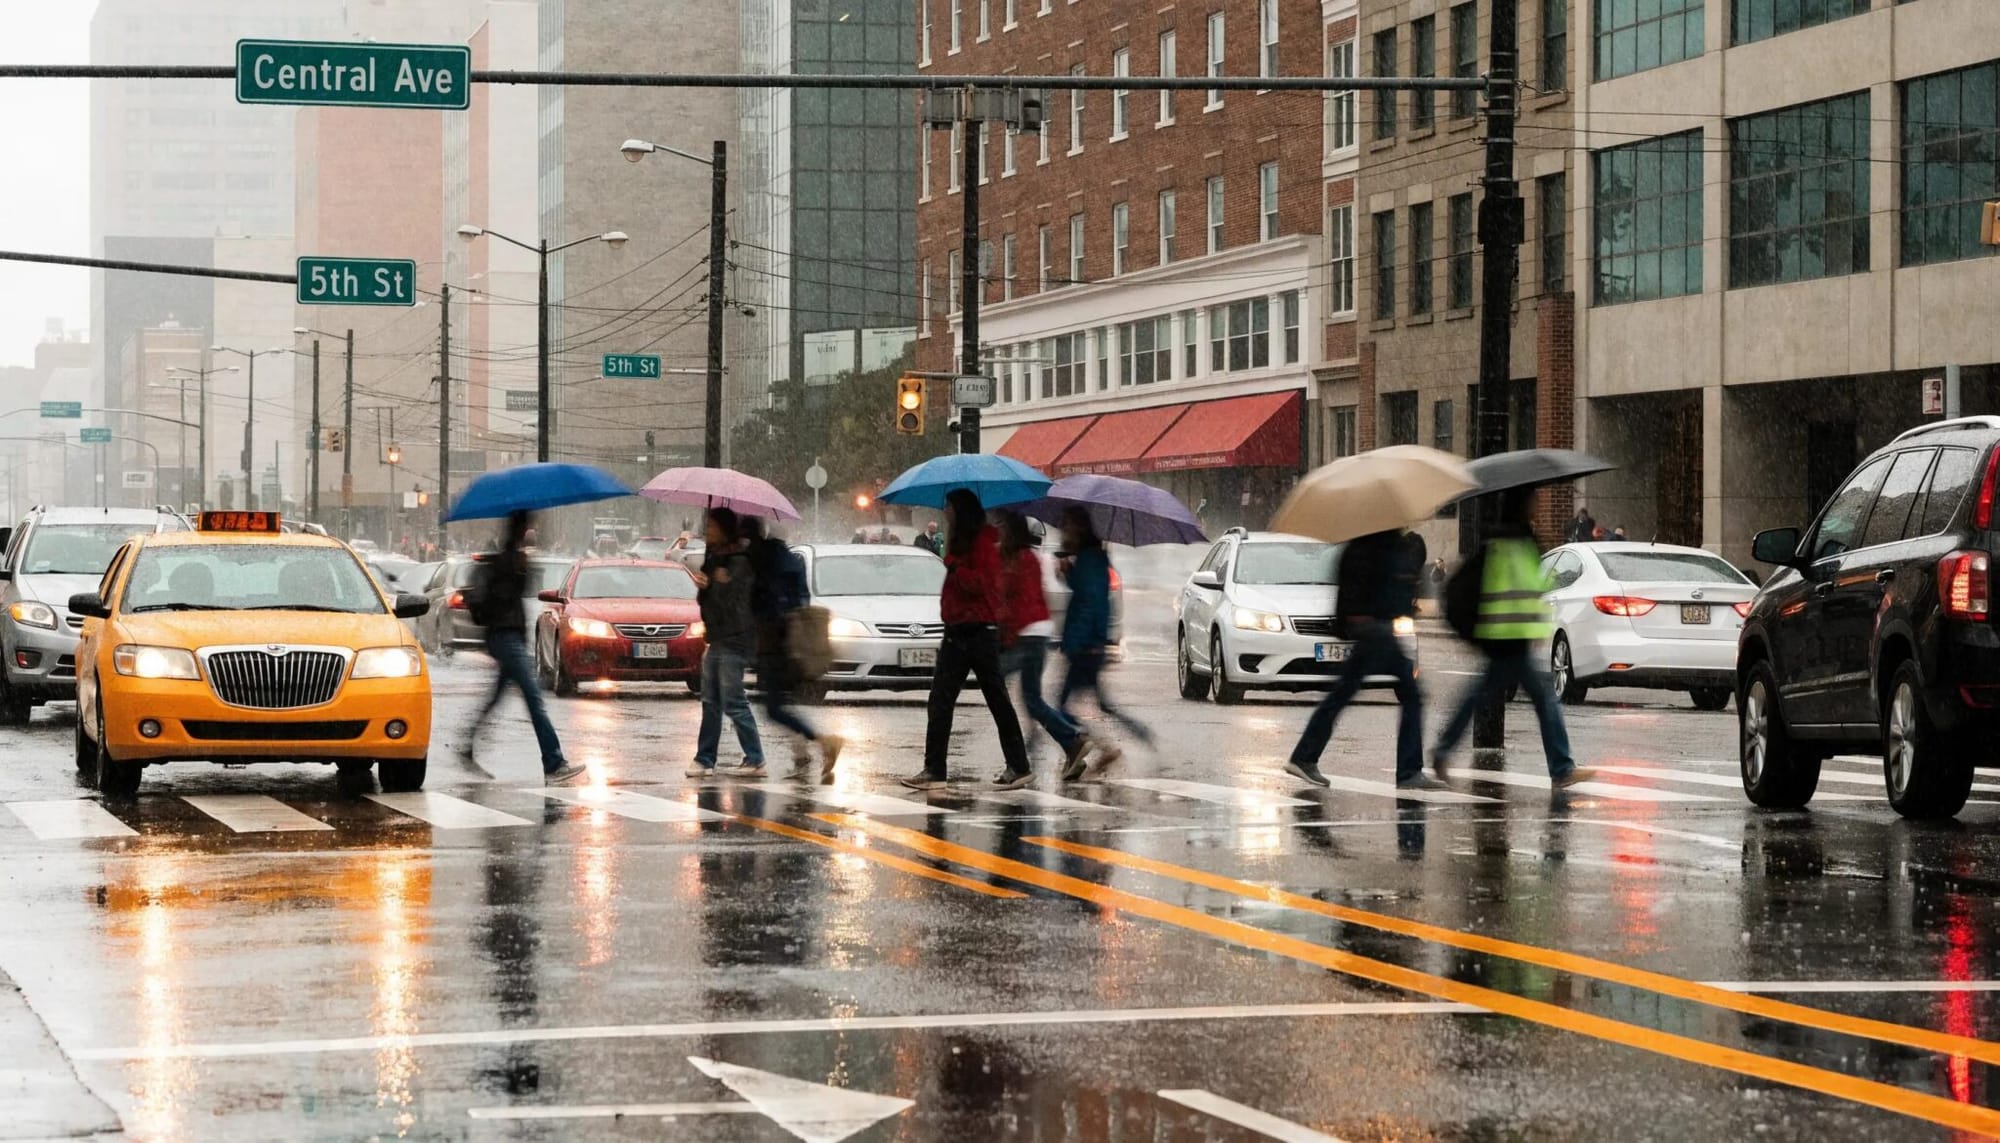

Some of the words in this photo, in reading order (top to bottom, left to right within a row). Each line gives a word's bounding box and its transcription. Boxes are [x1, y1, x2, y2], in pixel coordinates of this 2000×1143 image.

[254, 53, 377, 92] Central
[394, 58, 454, 95] Ave
[310, 266, 359, 297] 5th
[373, 268, 405, 298] St
[608, 357, 633, 373] 5th
[640, 359, 656, 375] St
